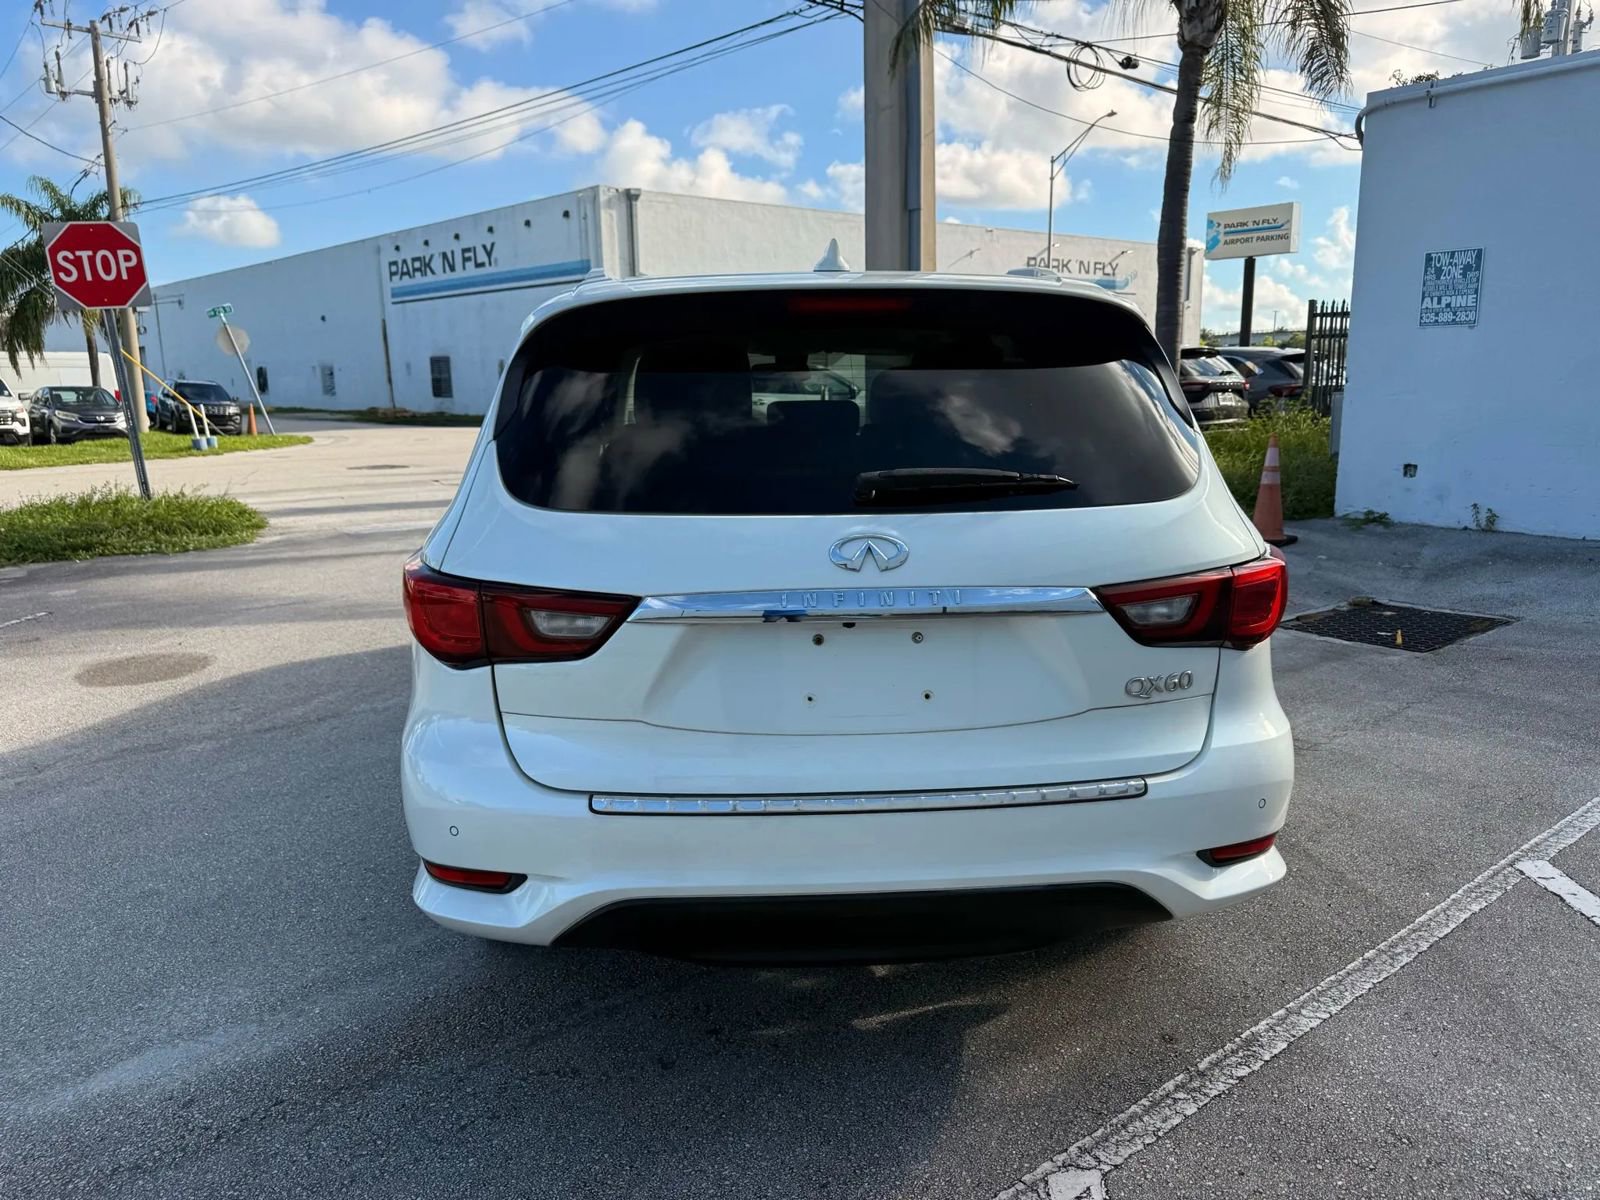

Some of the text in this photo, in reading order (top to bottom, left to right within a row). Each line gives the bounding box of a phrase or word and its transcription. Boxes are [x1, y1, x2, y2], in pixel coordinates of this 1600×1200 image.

[1223, 233, 1289, 246] AIRPORT PARKING
[57, 249, 137, 283] STOP
[1431, 250, 1477, 267] TOW-AWAY
[388, 254, 436, 282] PARK
[1093, 261, 1119, 276] FLY
[1441, 265, 1463, 280] ZONE
[1421, 295, 1477, 309] ALPINE
[781, 590, 960, 608] INFINITI
[1125, 669, 1193, 699] QX60
